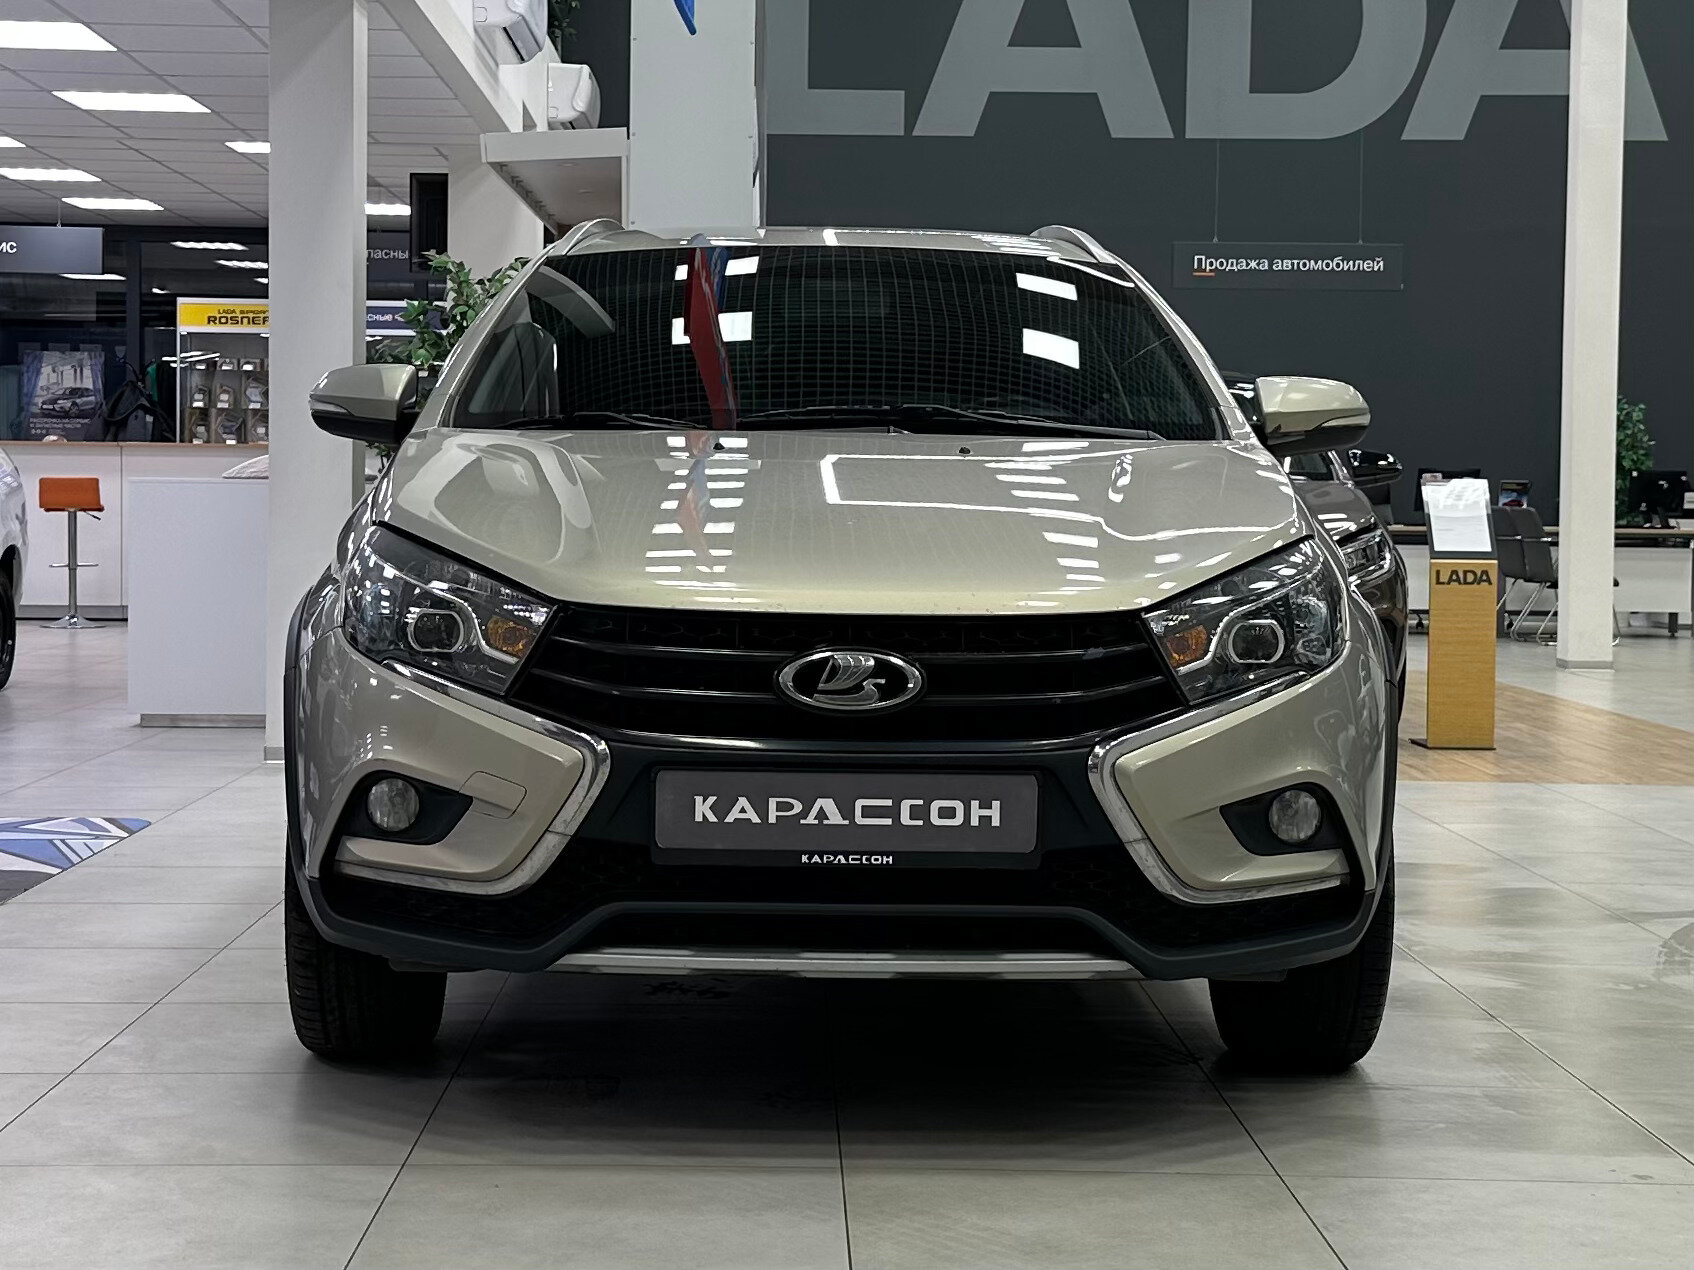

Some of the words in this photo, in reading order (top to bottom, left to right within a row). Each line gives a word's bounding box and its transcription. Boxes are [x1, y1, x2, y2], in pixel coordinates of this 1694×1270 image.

[765, 0, 1668, 141] LADA
[1193, 255, 1269, 272] Продажа
[1272, 256, 1384, 272] автомобилей
[1435, 569, 1492, 586] LADA
